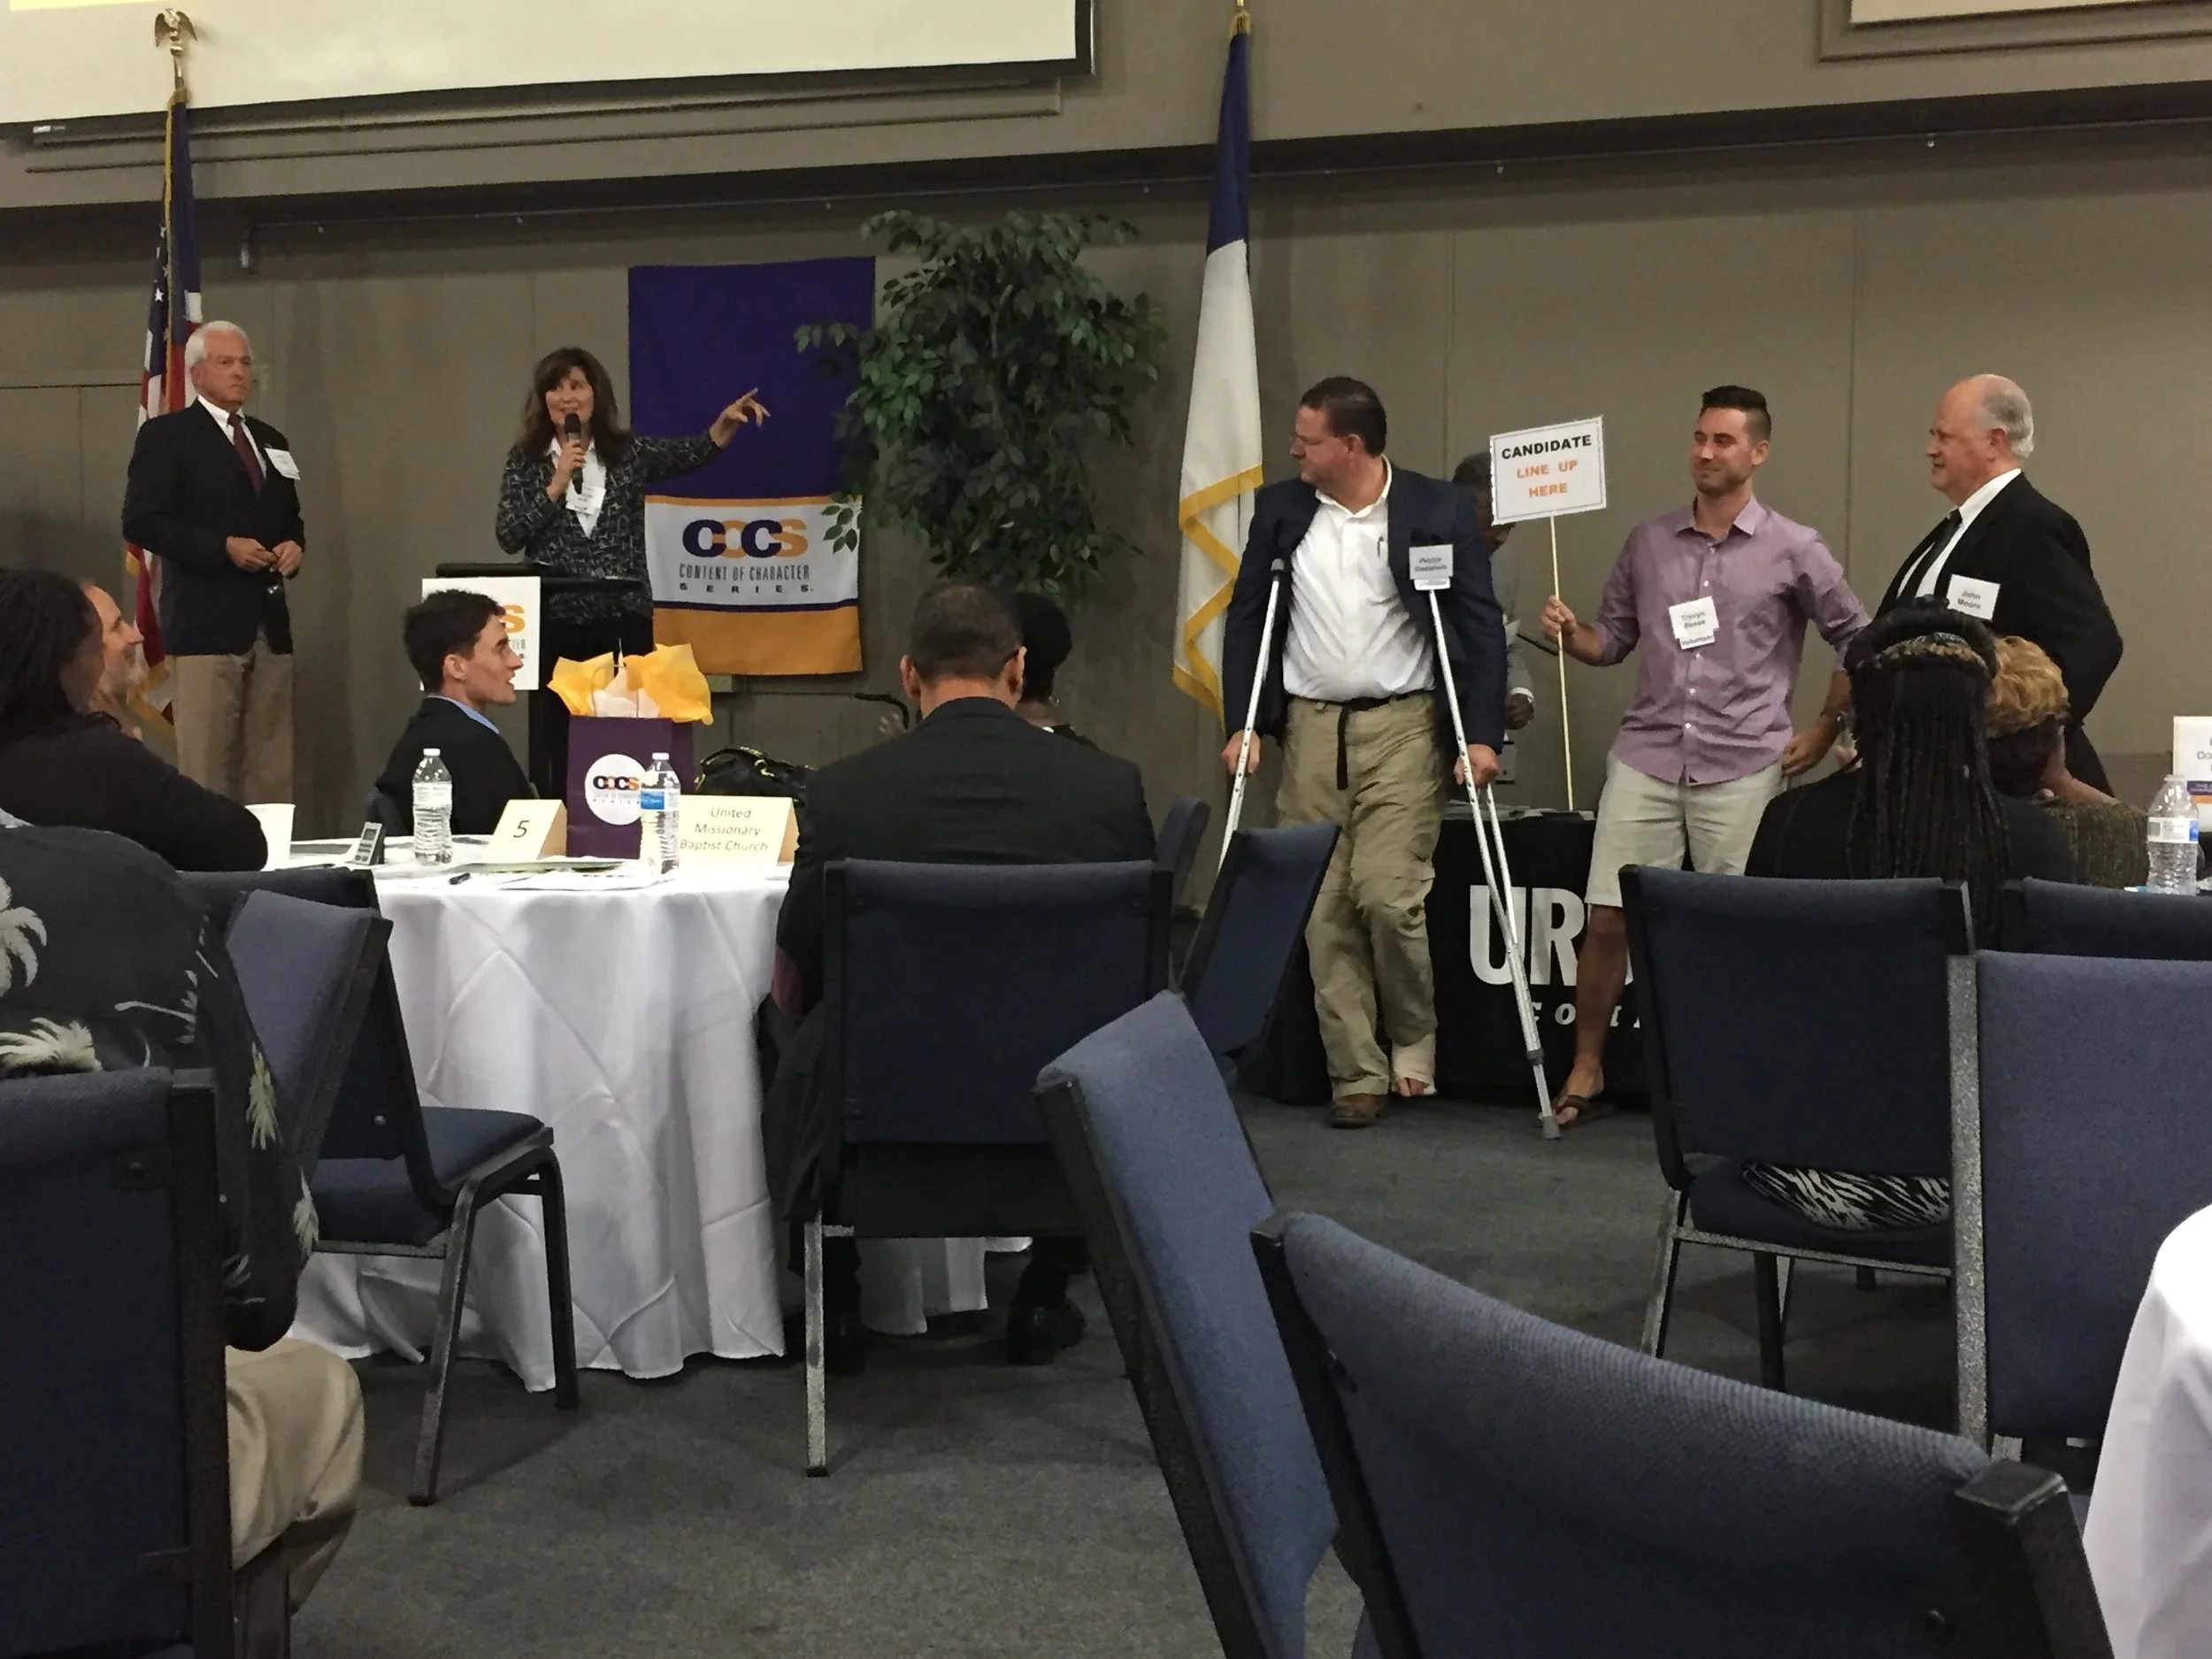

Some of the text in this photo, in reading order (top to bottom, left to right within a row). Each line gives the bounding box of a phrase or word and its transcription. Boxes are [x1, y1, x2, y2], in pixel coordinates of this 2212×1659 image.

[1502, 434, 1592, 459] CANDIDATE
[1517, 460, 1578, 479] LINE UP
[1528, 482, 1568, 497] HERE
[679, 563, 810, 581] CONTENT OF CHARACTER
[1962, 590, 1981, 600] John
[1957, 598, 1981, 609] Moore
[710, 807, 751, 818] United
[513, 819, 530, 838] 5
[695, 823, 761, 836] Missionary
[680, 839, 768, 851] Baptist Church
